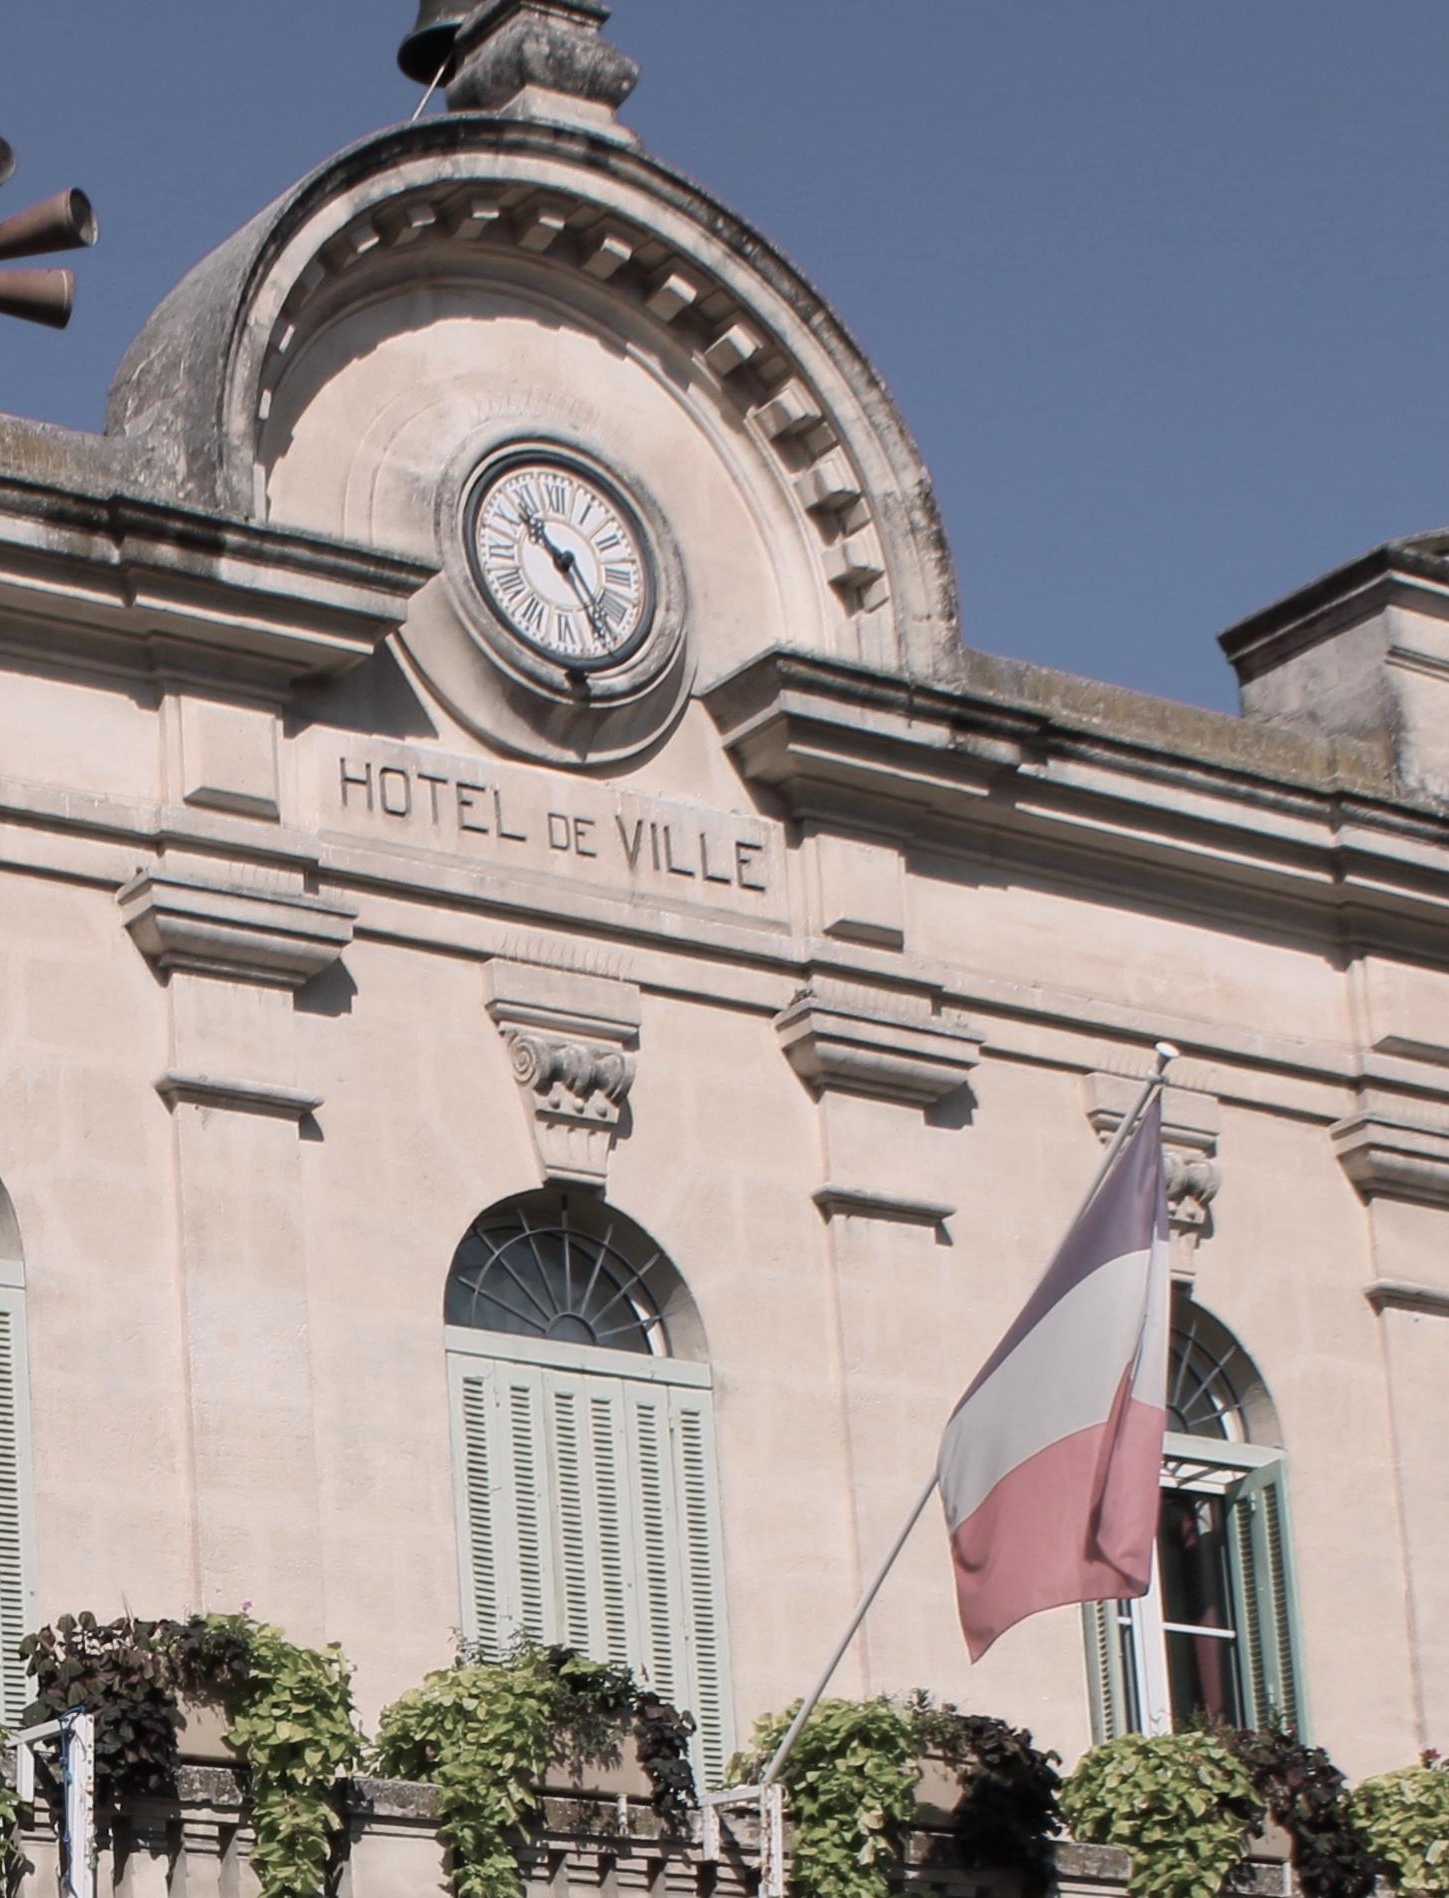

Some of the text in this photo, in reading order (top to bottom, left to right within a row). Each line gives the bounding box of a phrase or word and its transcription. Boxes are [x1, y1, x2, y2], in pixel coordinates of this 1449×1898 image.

[340, 757, 767, 893] HOTEL DE VILLE
